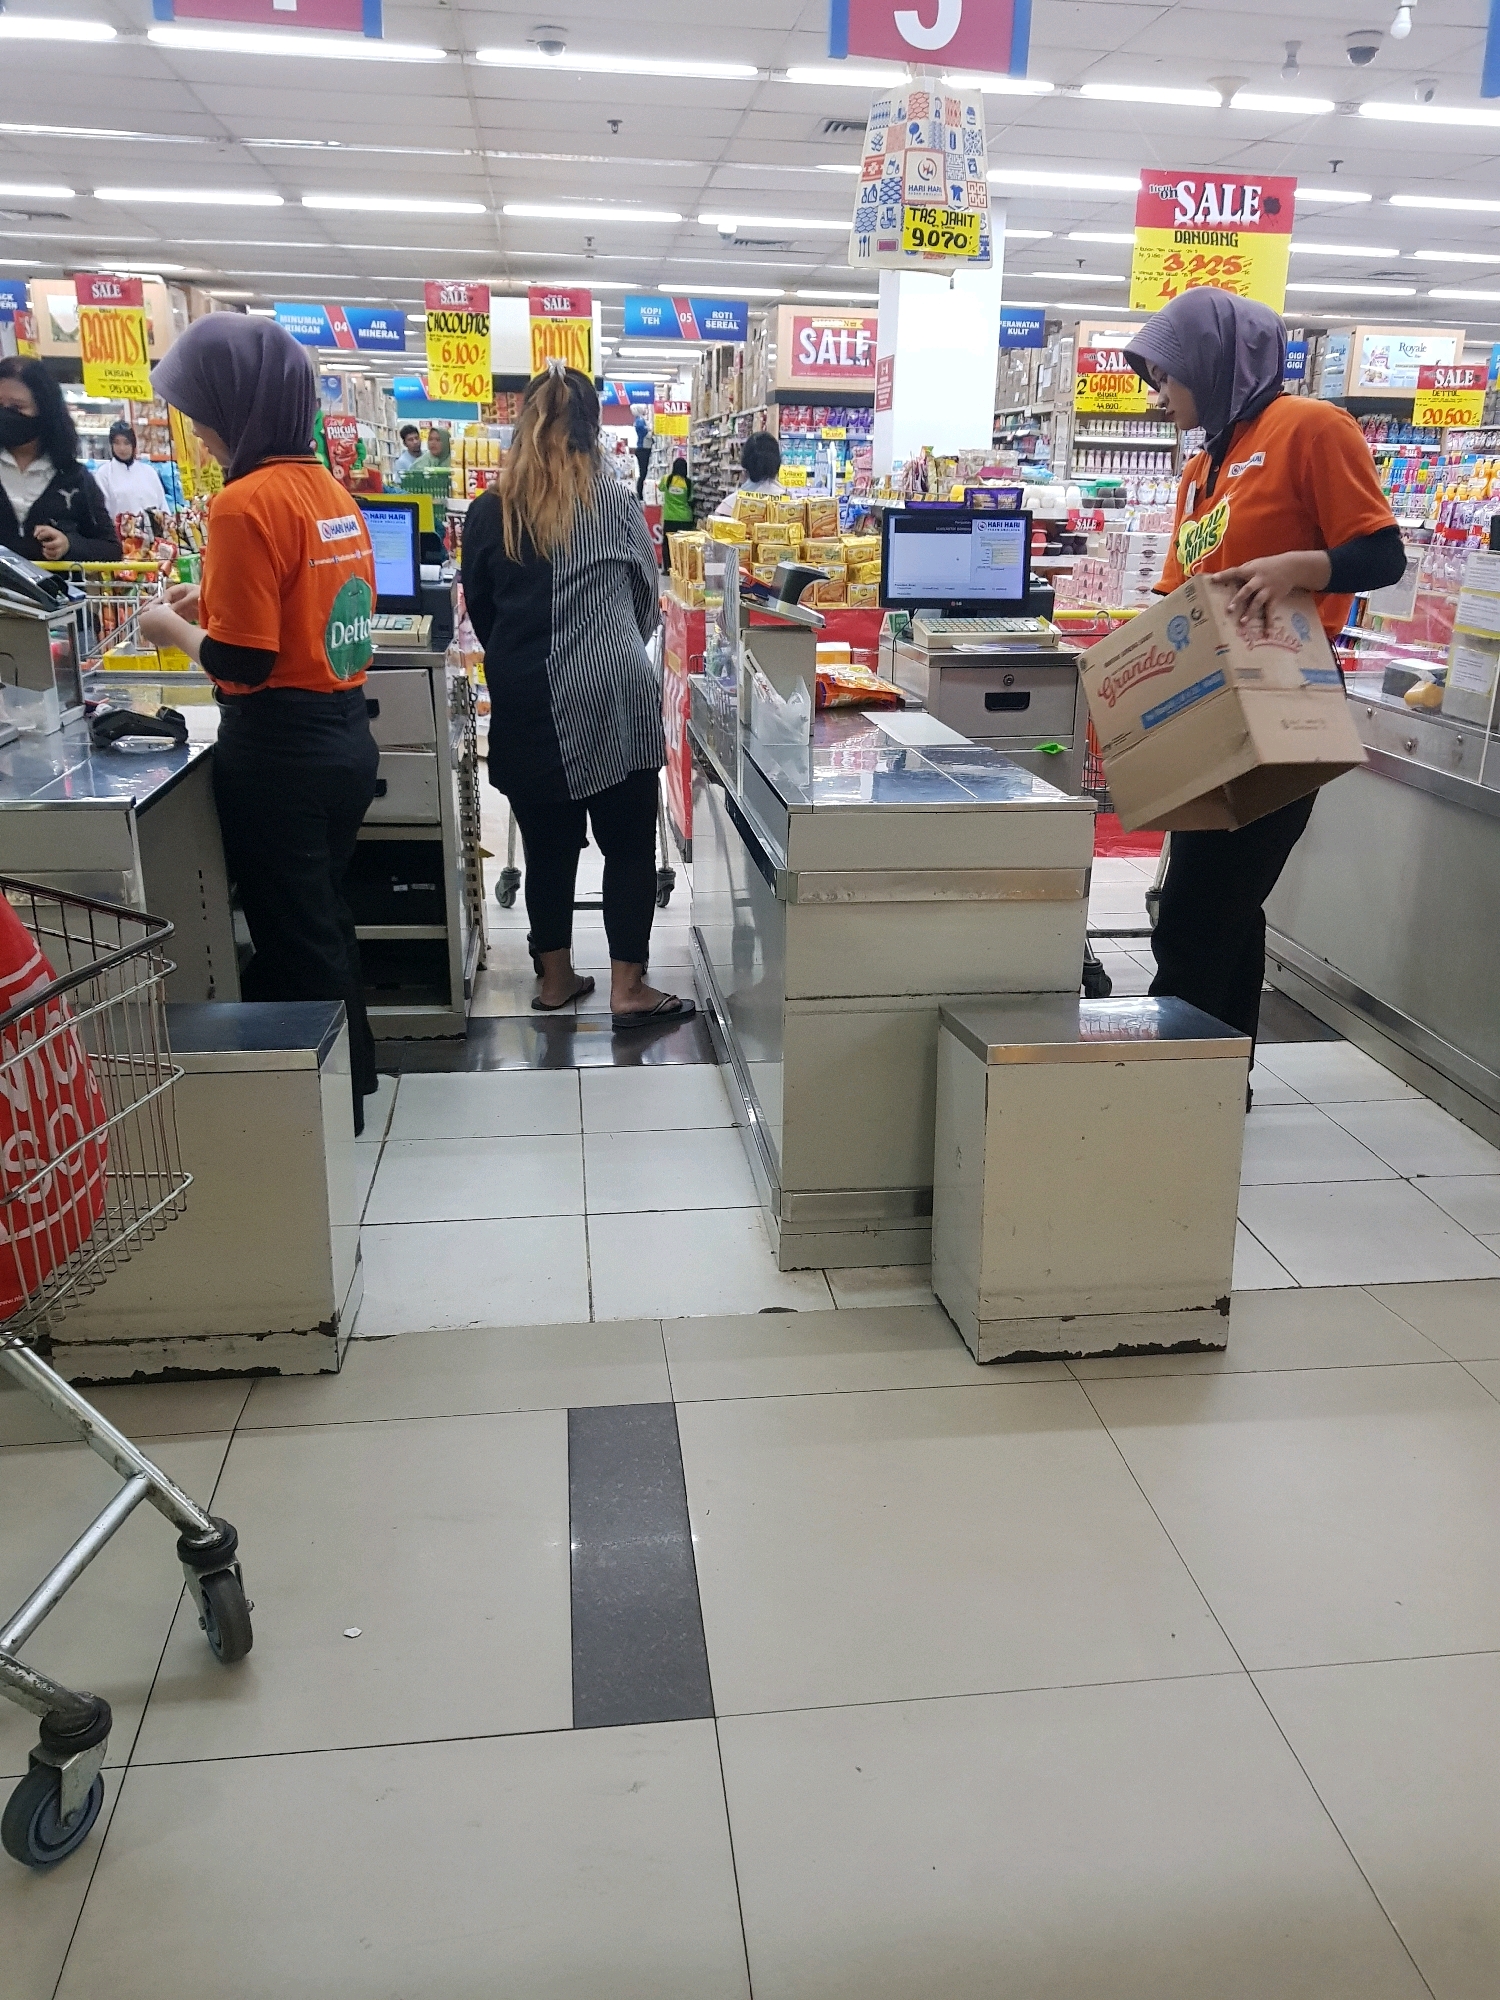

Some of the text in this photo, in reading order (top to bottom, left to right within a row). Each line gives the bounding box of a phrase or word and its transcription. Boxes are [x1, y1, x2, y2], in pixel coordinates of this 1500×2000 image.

[908, 184, 926, 193] HARI
[1174, 180, 1263, 226] SALE
[909, 207, 975, 228] TAS JAHIT
[91, 281, 122, 299] SALE
[440, 290, 469, 305] SALE
[543, 296, 571, 311] SALE
[640, 306, 662, 316] KOPI
[711, 311, 733, 320] ROTI
[279, 315, 325, 325] MINUMAN
[641, 316, 661, 325] TEH
[679, 312, 693, 323] 05
[334, 321, 348, 332] 04
[370, 320, 387, 330] AIR
[705, 320, 740, 330] SEREAL
[358, 329, 400, 339] MINERAL
[1007, 328, 1030, 336] KULIT
[798, 327, 871, 367] SALE
[1398, 341, 1427, 359] Royale
[1288, 351, 1305, 360] GIGI
[1286, 360, 1303, 369] GIGI
[1434, 368, 1475, 387] SALE
[1076, 378, 1088, 395] 2
[1089, 374, 1135, 394] GRATIS
[663, 402, 688, 413] SALE
[326, 424, 356, 440] pucuk
[369, 512, 406, 521] HARI HARI
[331, 521, 358, 535] HARI HARI
[1004, 521, 1020, 529] HARI
[1074, 520, 1098, 531] SALE
[1097, 644, 1176, 708] Grandco
